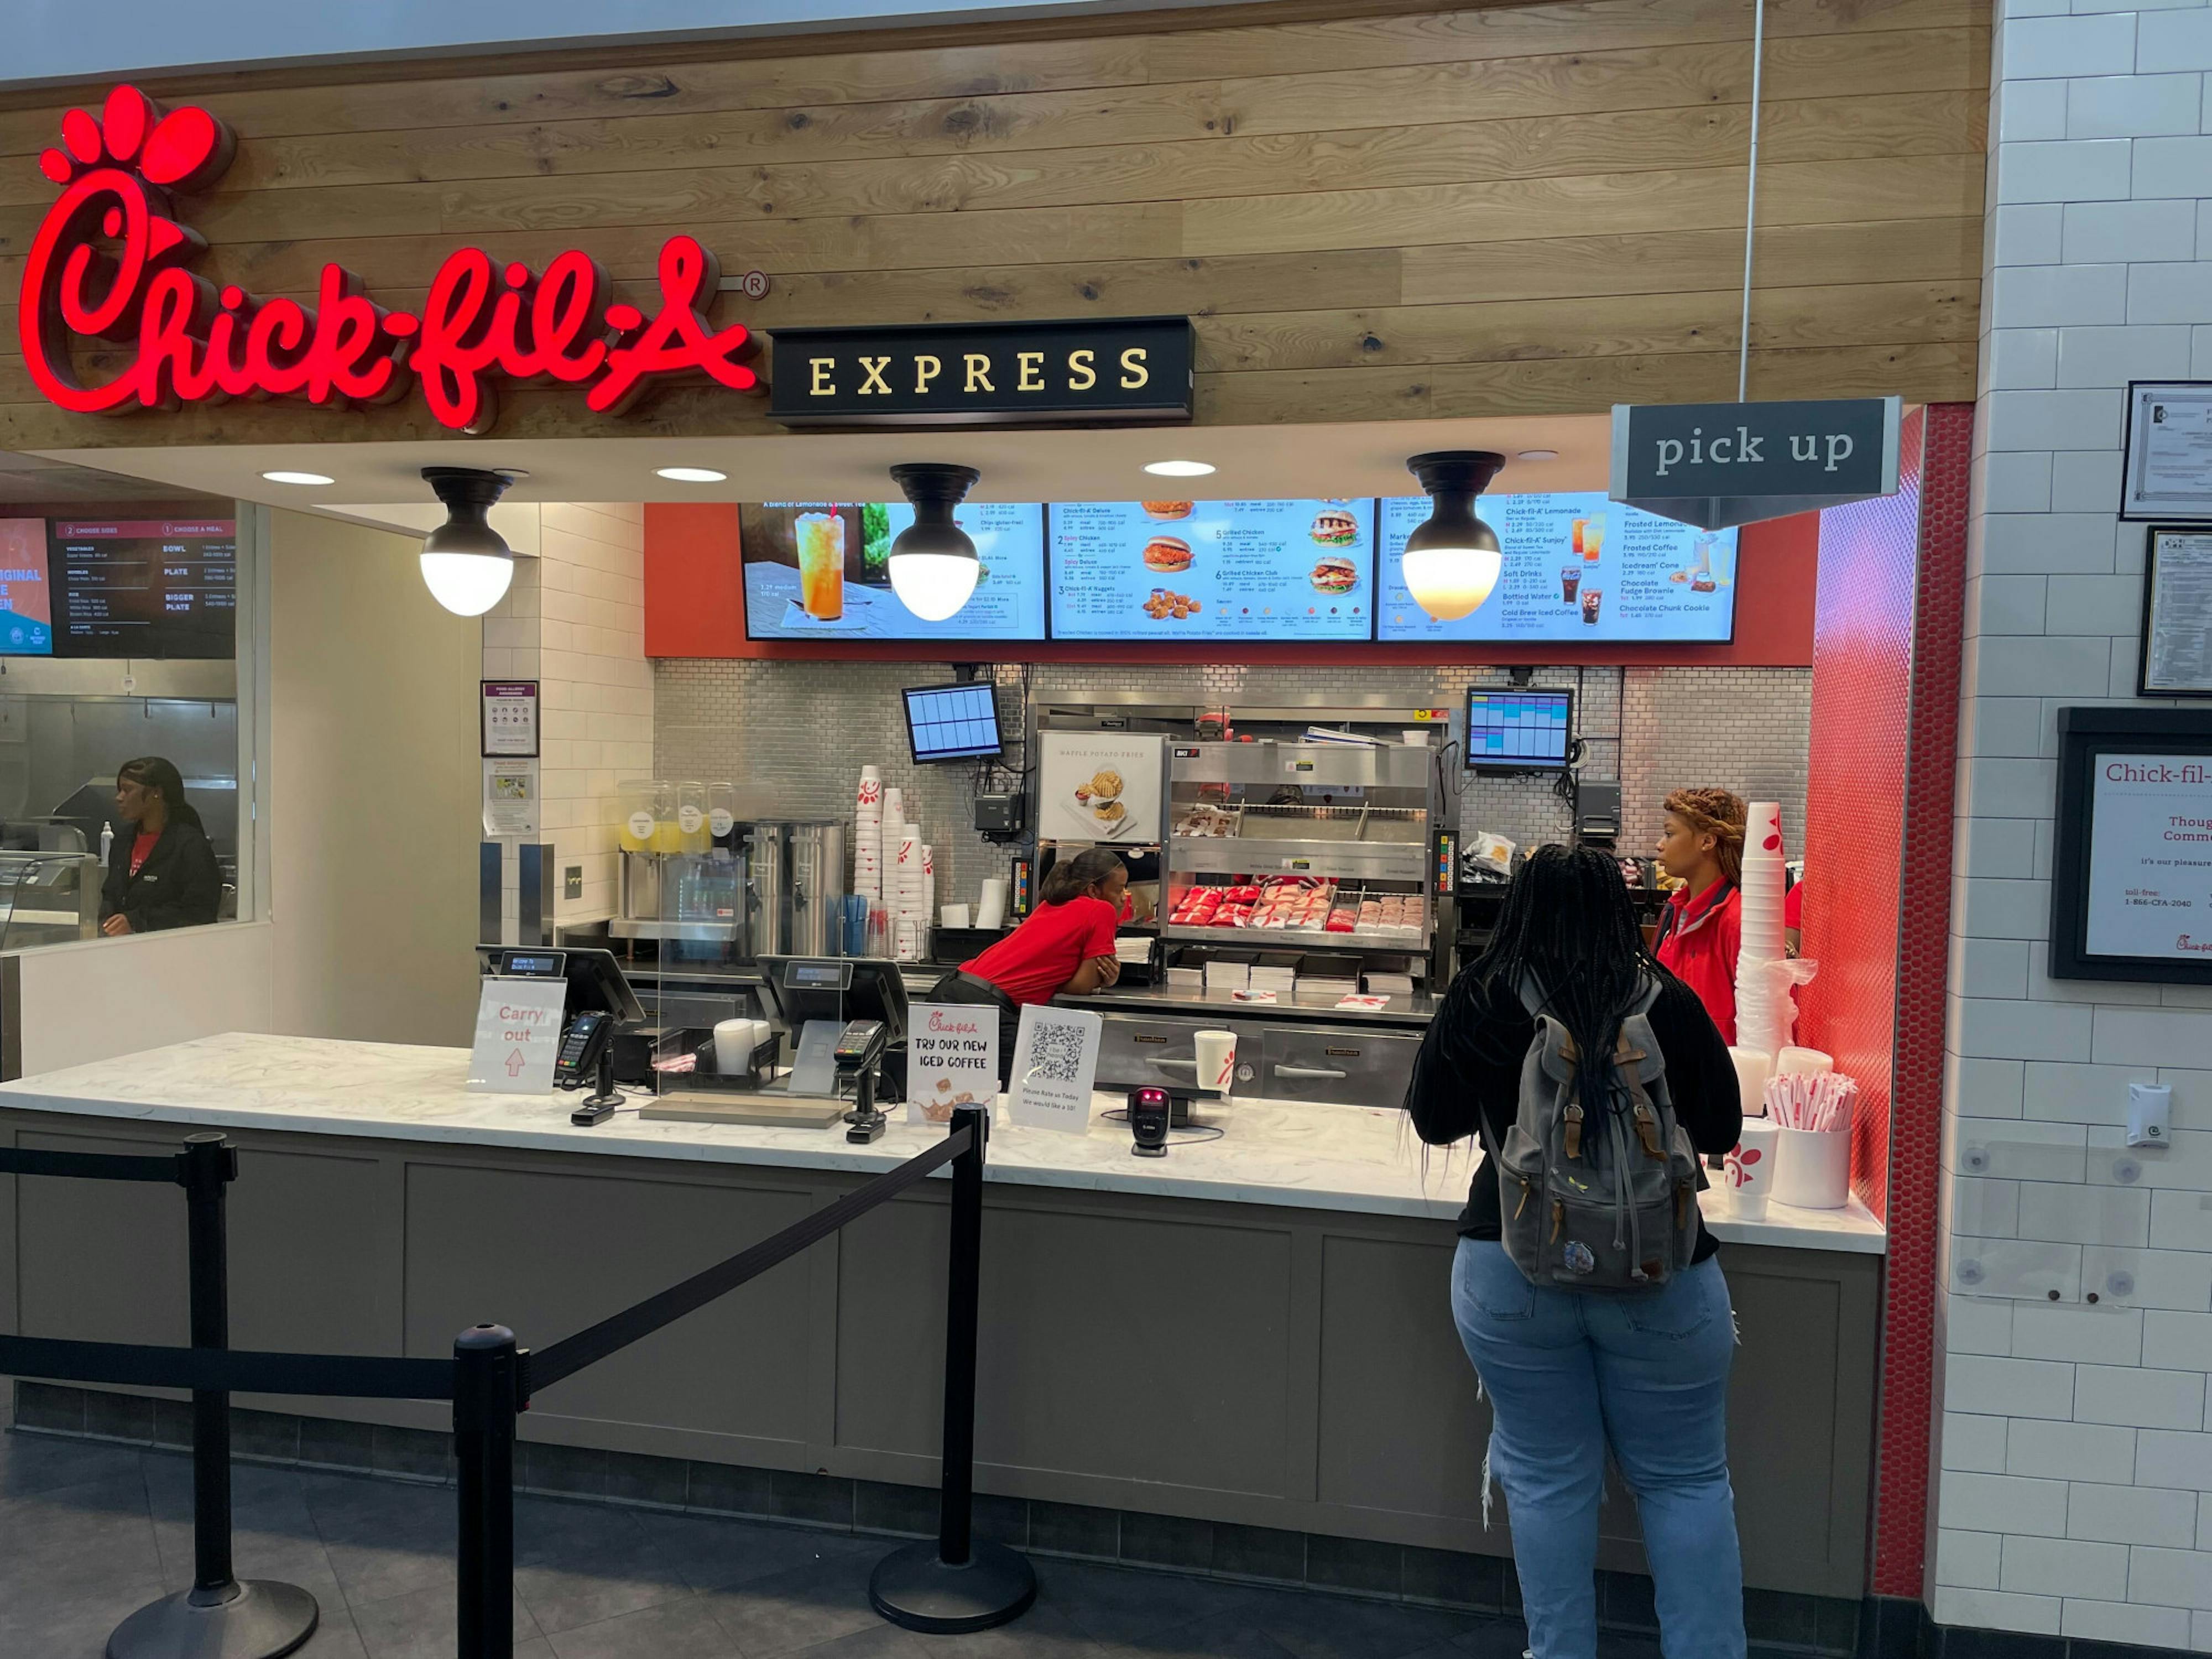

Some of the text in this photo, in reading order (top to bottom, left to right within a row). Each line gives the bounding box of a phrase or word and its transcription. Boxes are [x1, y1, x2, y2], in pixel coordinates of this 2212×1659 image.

[19, 84, 757, 430] Chick-fil-A
[808, 347, 1150, 397] EXPRESS
[1656, 426, 1854, 476] pick up
[1057, 535, 1063, 545] 2
[1216, 530, 1222, 539] 5
[1215, 570, 1222, 580] 6
[1058, 586, 1065, 594] 3
[2106, 764, 2212, 783] Chick-fil-
[2164, 831, 2212, 842] Comm
[2125, 899, 2192, 907] 1-866-CFA-2040
[499, 1006, 543, 1024] Carry
[929, 1011, 978, 1035] Chick-fil-A
[504, 1029, 531, 1041] out
[916, 1039, 935, 1050] TRY
[939, 1040, 959, 1051] OUR
[920, 1056, 987, 1069] ICED COFFEE
[1062, 1093, 1079, 1101] Today
